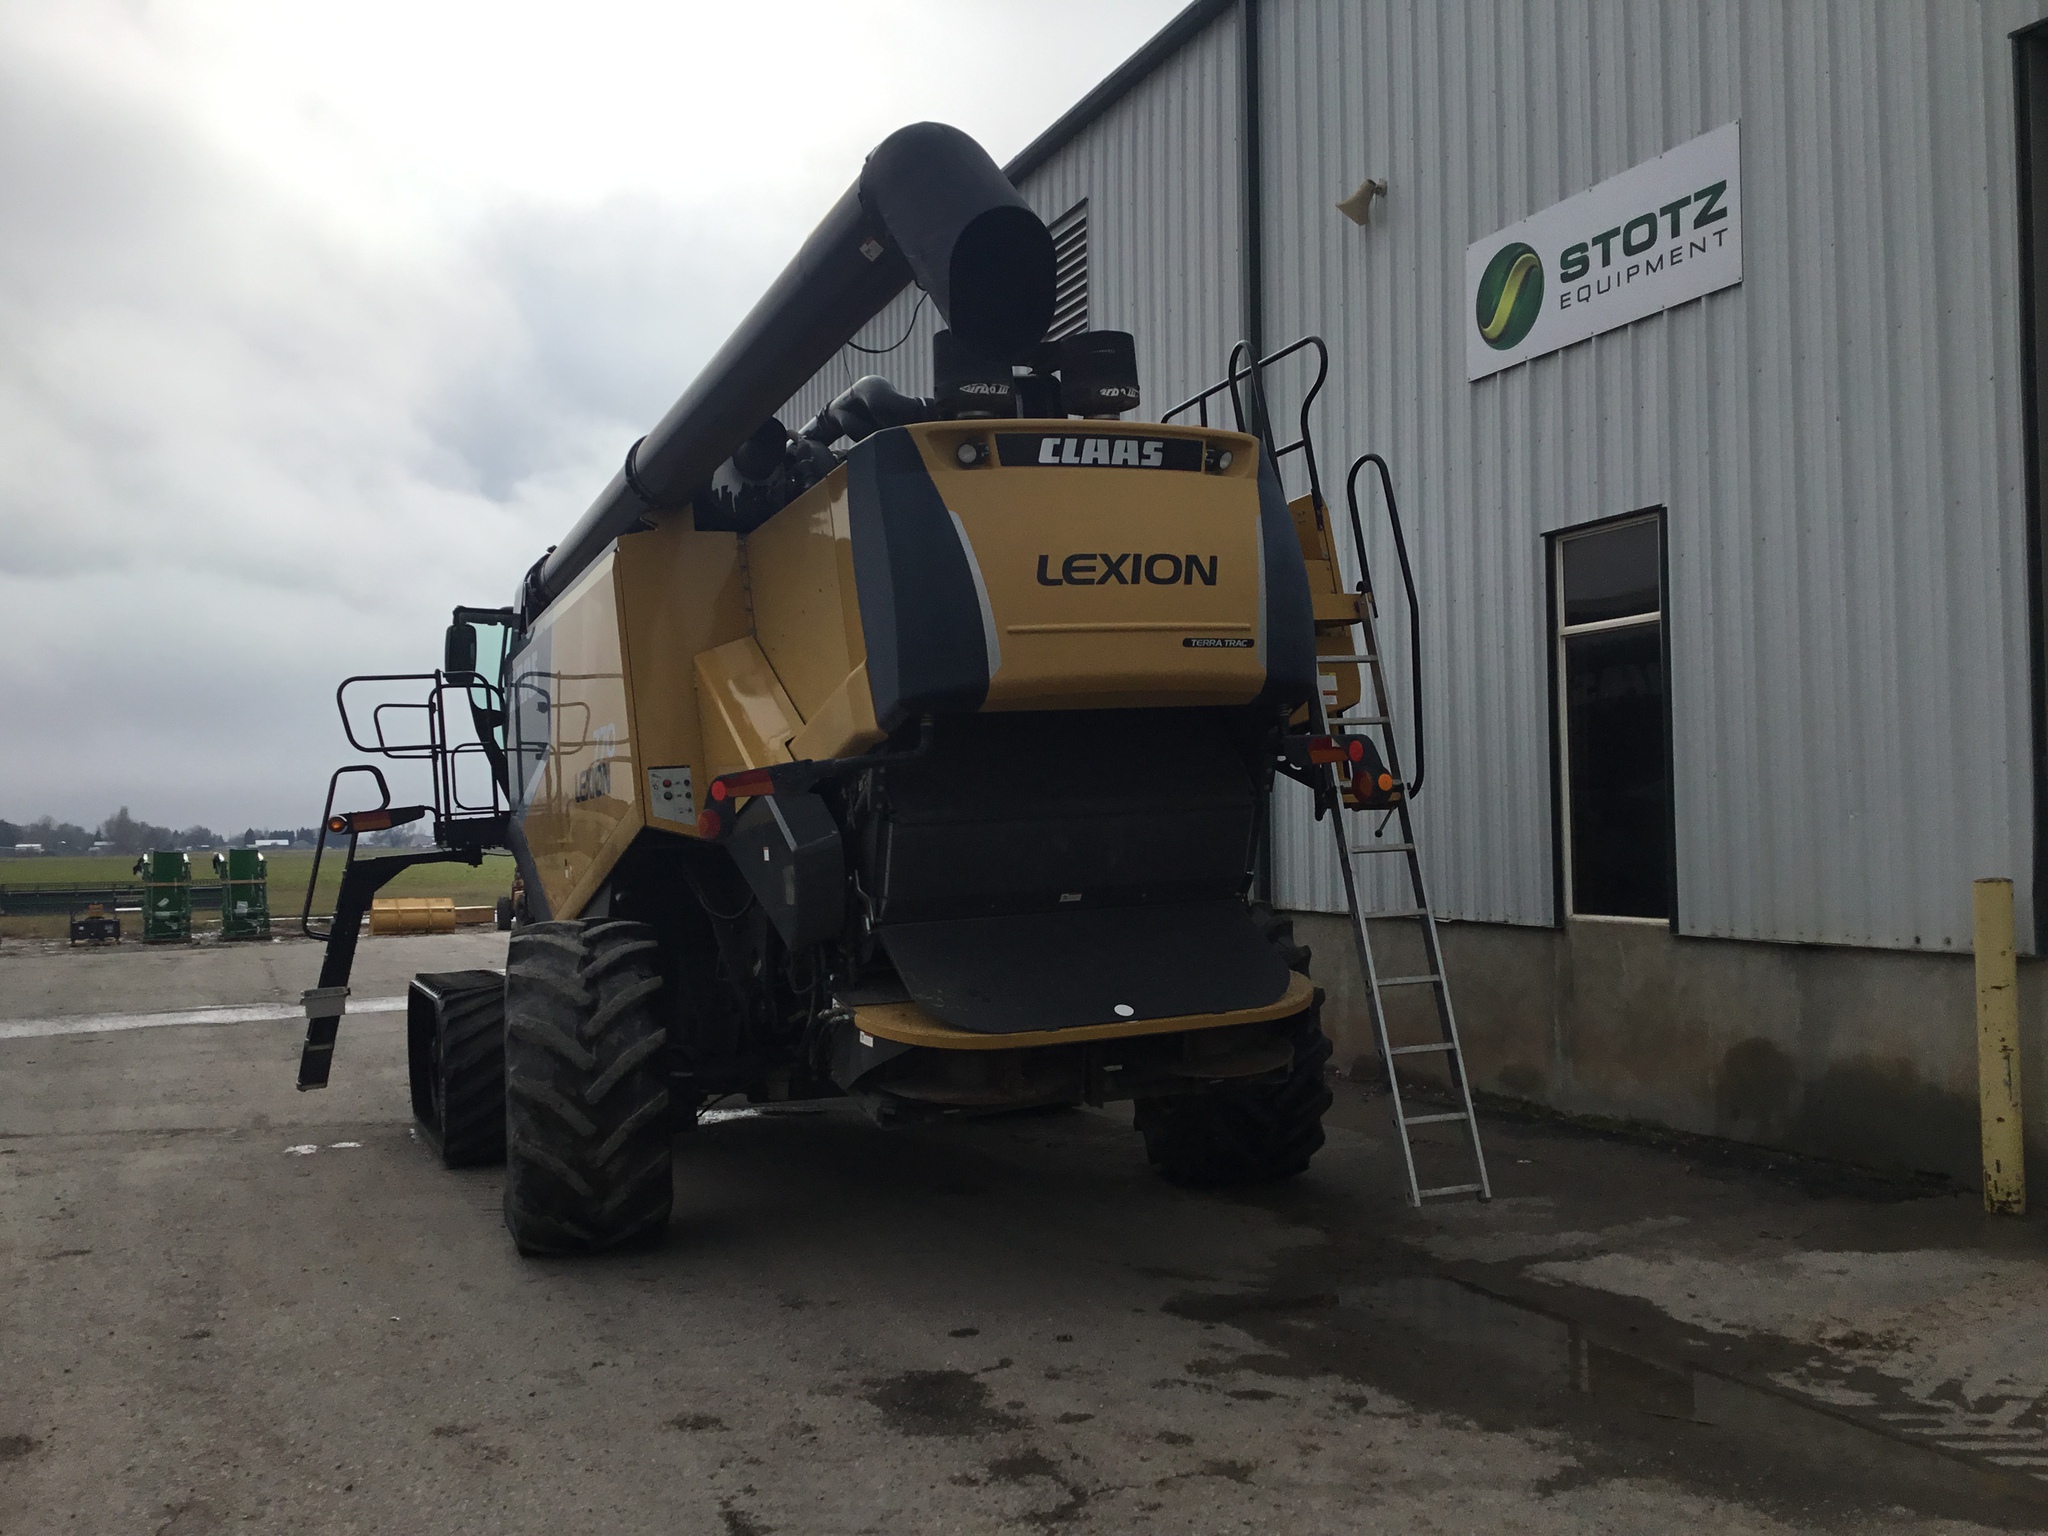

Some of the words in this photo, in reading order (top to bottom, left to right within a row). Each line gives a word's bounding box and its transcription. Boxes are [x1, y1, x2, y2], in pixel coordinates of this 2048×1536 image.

[1560, 179, 1728, 283] STOTZ
[1560, 228, 1728, 310] EQUIPMENT
[1037, 437, 1164, 467] CLAAS
[1036, 553, 1218, 586] LEXION
[1191, 639, 1222, 647] TERRA
[1225, 639, 1248, 647] TRAC
